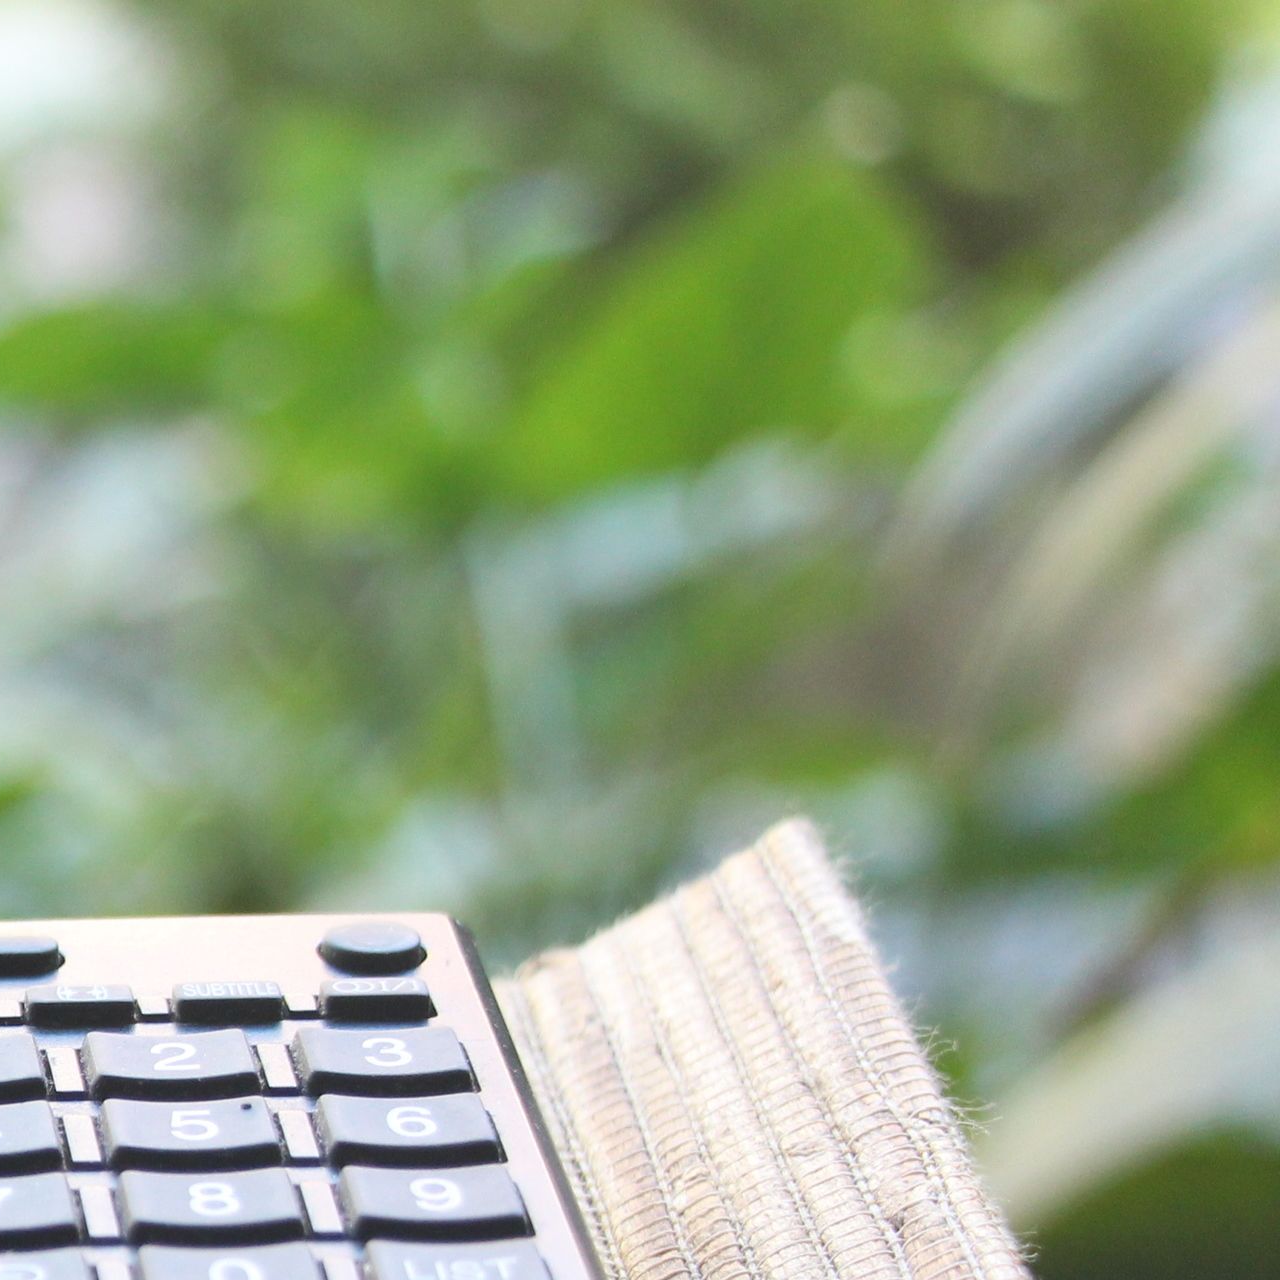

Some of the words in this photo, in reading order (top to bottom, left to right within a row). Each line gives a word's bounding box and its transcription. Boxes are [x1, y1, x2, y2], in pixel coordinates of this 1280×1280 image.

[182, 982, 279, 997] SUBTITLE
[150, 1042, 201, 1071] 2
[362, 1038, 413, 1067] 3
[170, 1110, 219, 1141] 5
[386, 1106, 438, 1137] 6
[188, 1182, 241, 1216] 8
[407, 1178, 463, 1212] 9
